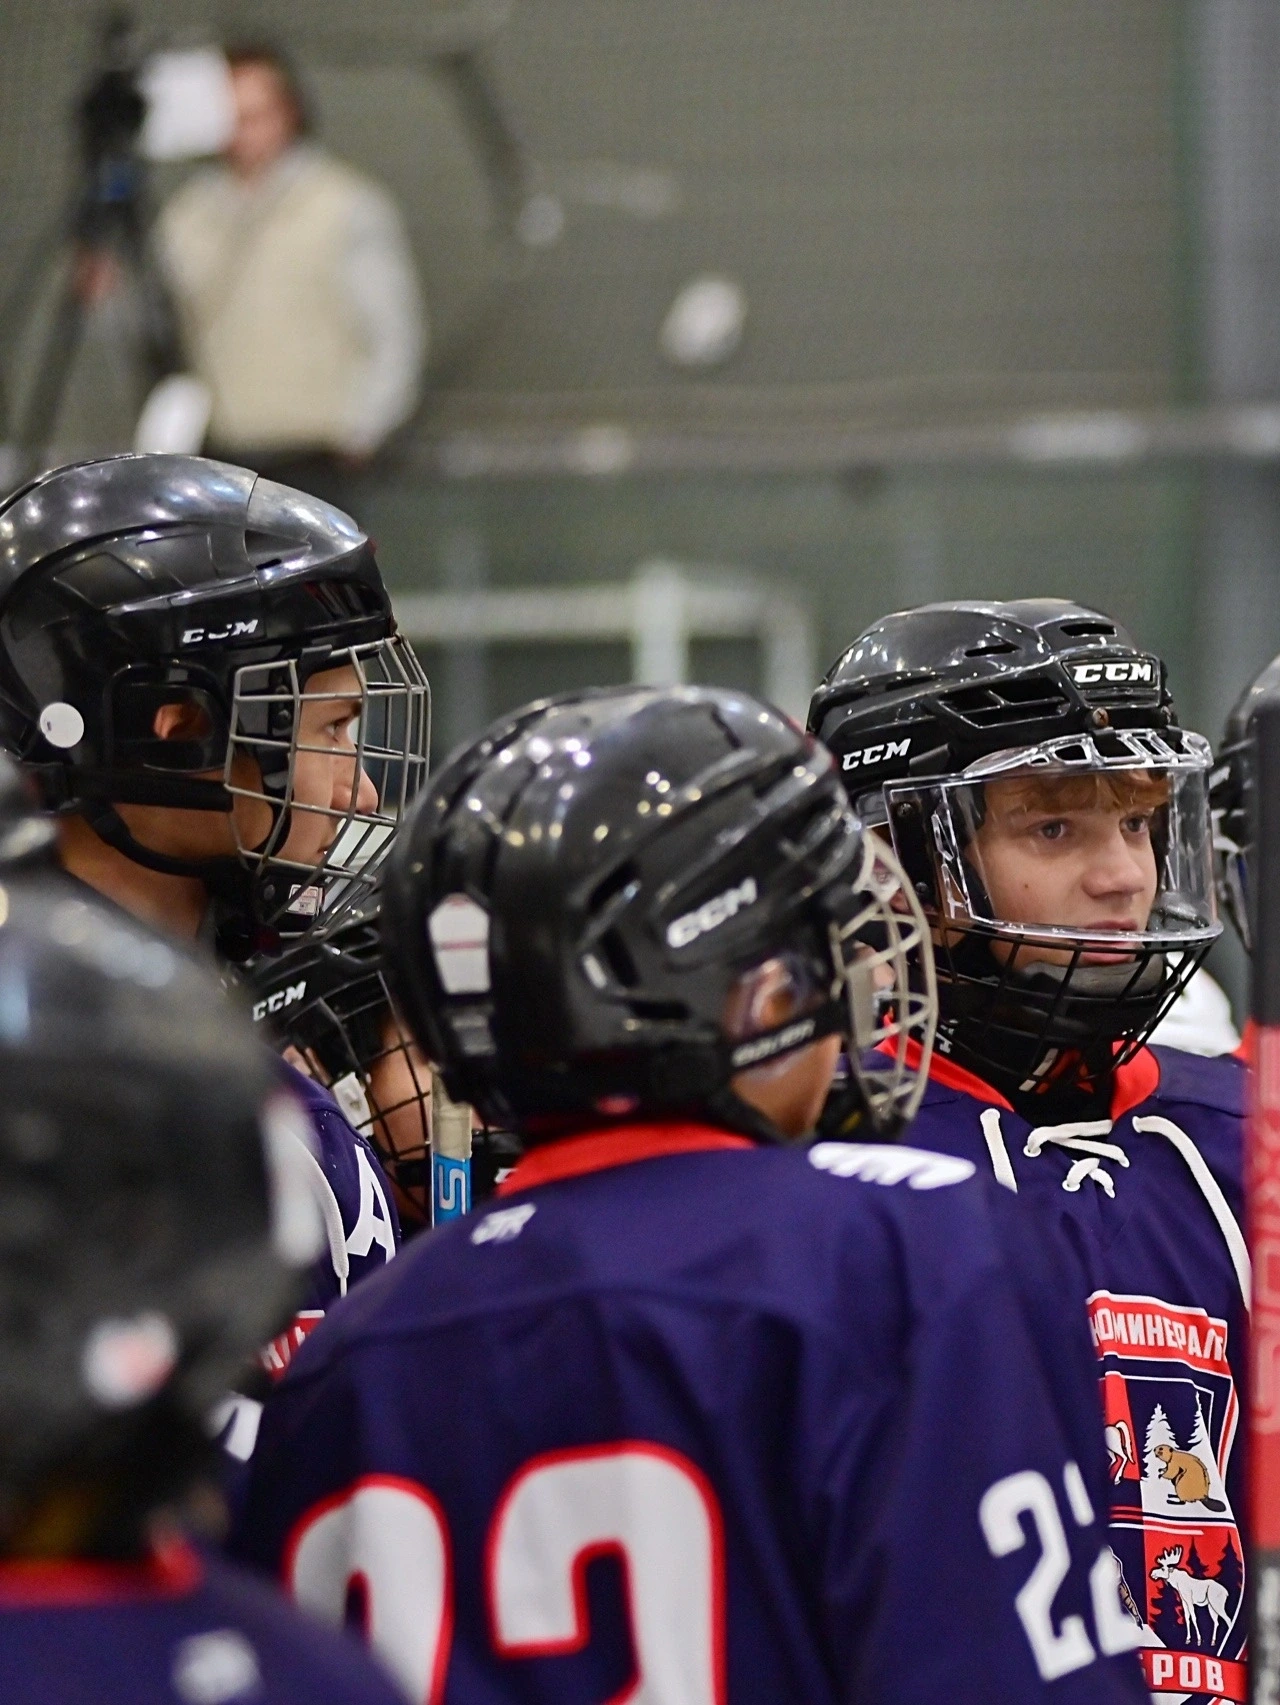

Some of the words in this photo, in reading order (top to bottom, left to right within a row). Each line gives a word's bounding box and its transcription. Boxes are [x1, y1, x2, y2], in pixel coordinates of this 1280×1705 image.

[1073, 662, 1152, 684] CCM
[842, 737, 911, 771] CCM
[252, 981, 307, 1022] CCM
[345, 1142, 397, 1265] A
